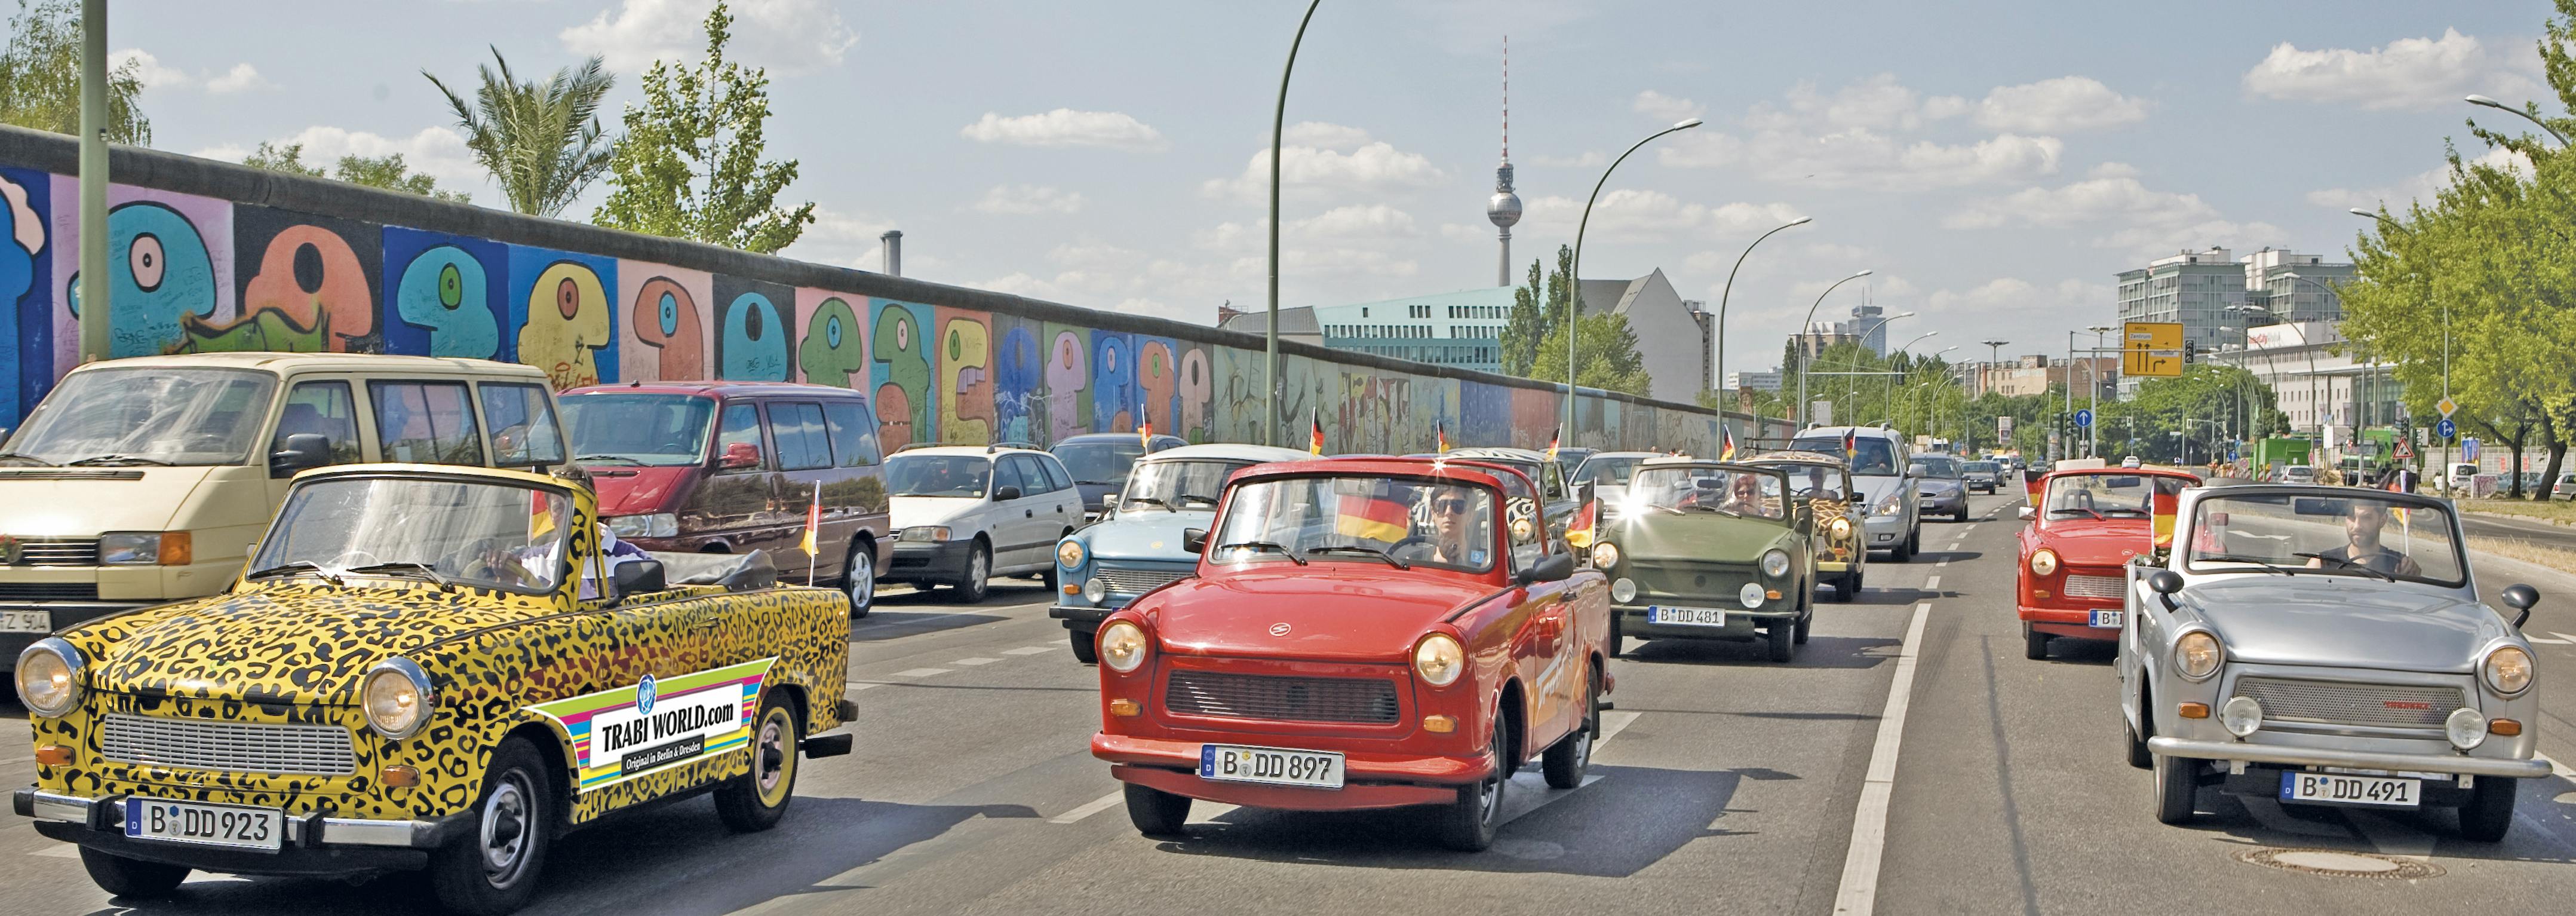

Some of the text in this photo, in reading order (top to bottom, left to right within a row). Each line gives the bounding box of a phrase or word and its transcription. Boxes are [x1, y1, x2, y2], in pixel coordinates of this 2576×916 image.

[5, 614, 16, 629] Z
[1661, 609, 1719, 623] B DD 481
[2102, 612, 2110, 624] B
[602, 703, 733, 752] TRABI WORLD.com
[626, 742, 701, 771] Original in Berlin & Dresden
[1224, 751, 1238, 774] B
[1254, 753, 1284, 777] DD
[1288, 755, 1332, 780] 897
[2302, 777, 2317, 796] B
[2333, 779, 2363, 799] DD
[2367, 781, 2408, 802] 491
[131, 805, 268, 841] D B DD 923
